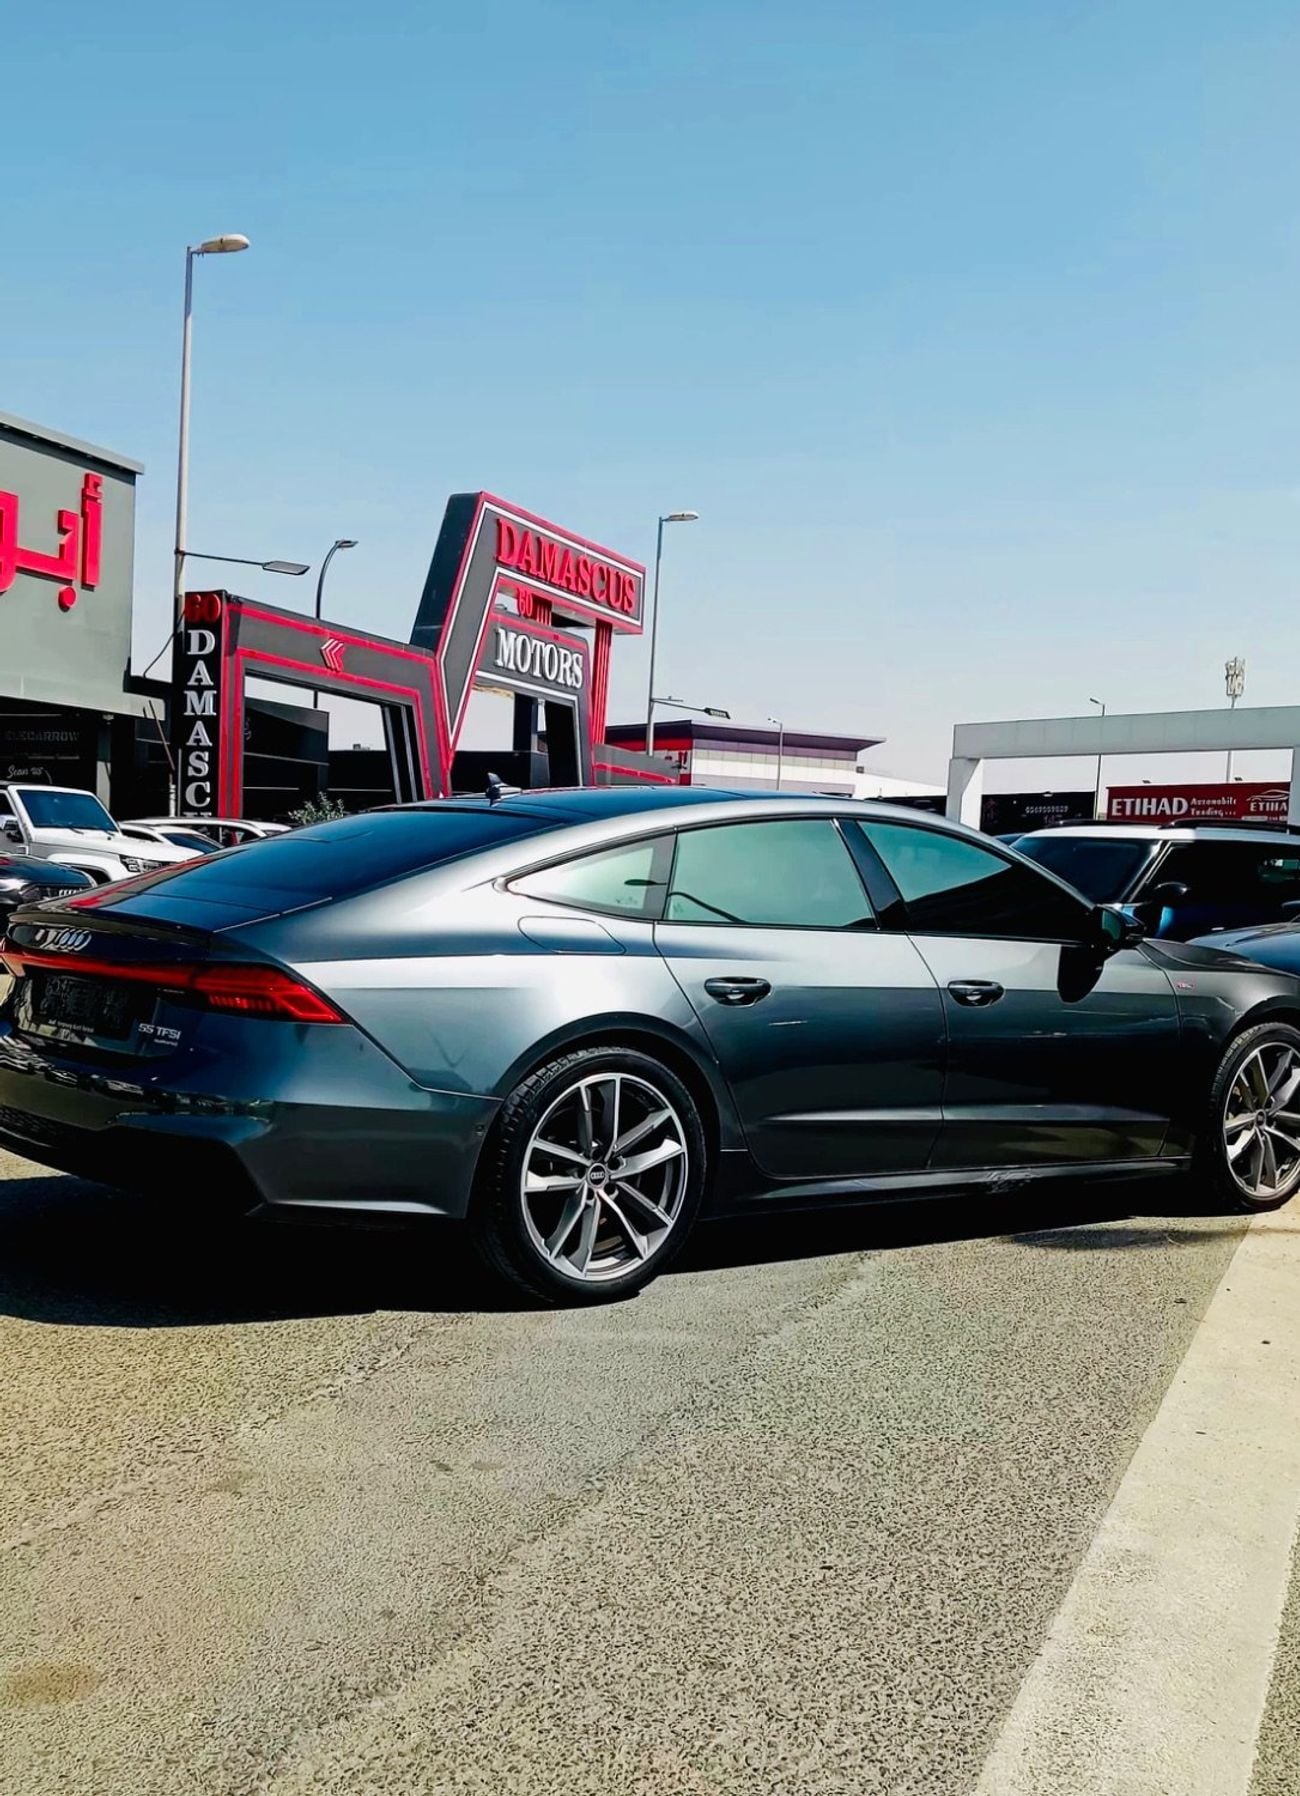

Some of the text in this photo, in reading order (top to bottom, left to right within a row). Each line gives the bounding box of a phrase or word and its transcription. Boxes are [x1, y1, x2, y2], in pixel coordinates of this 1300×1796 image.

[495, 518, 636, 615] DAMASCUS
[495, 627, 583, 689] MOTORS
[183, 629, 219, 818] DAMASC
[1111, 797, 1188, 816] ETIHAD
[1250, 801, 1288, 812] ETIHA
[138, 1023, 182, 1040] 55 TFSI
